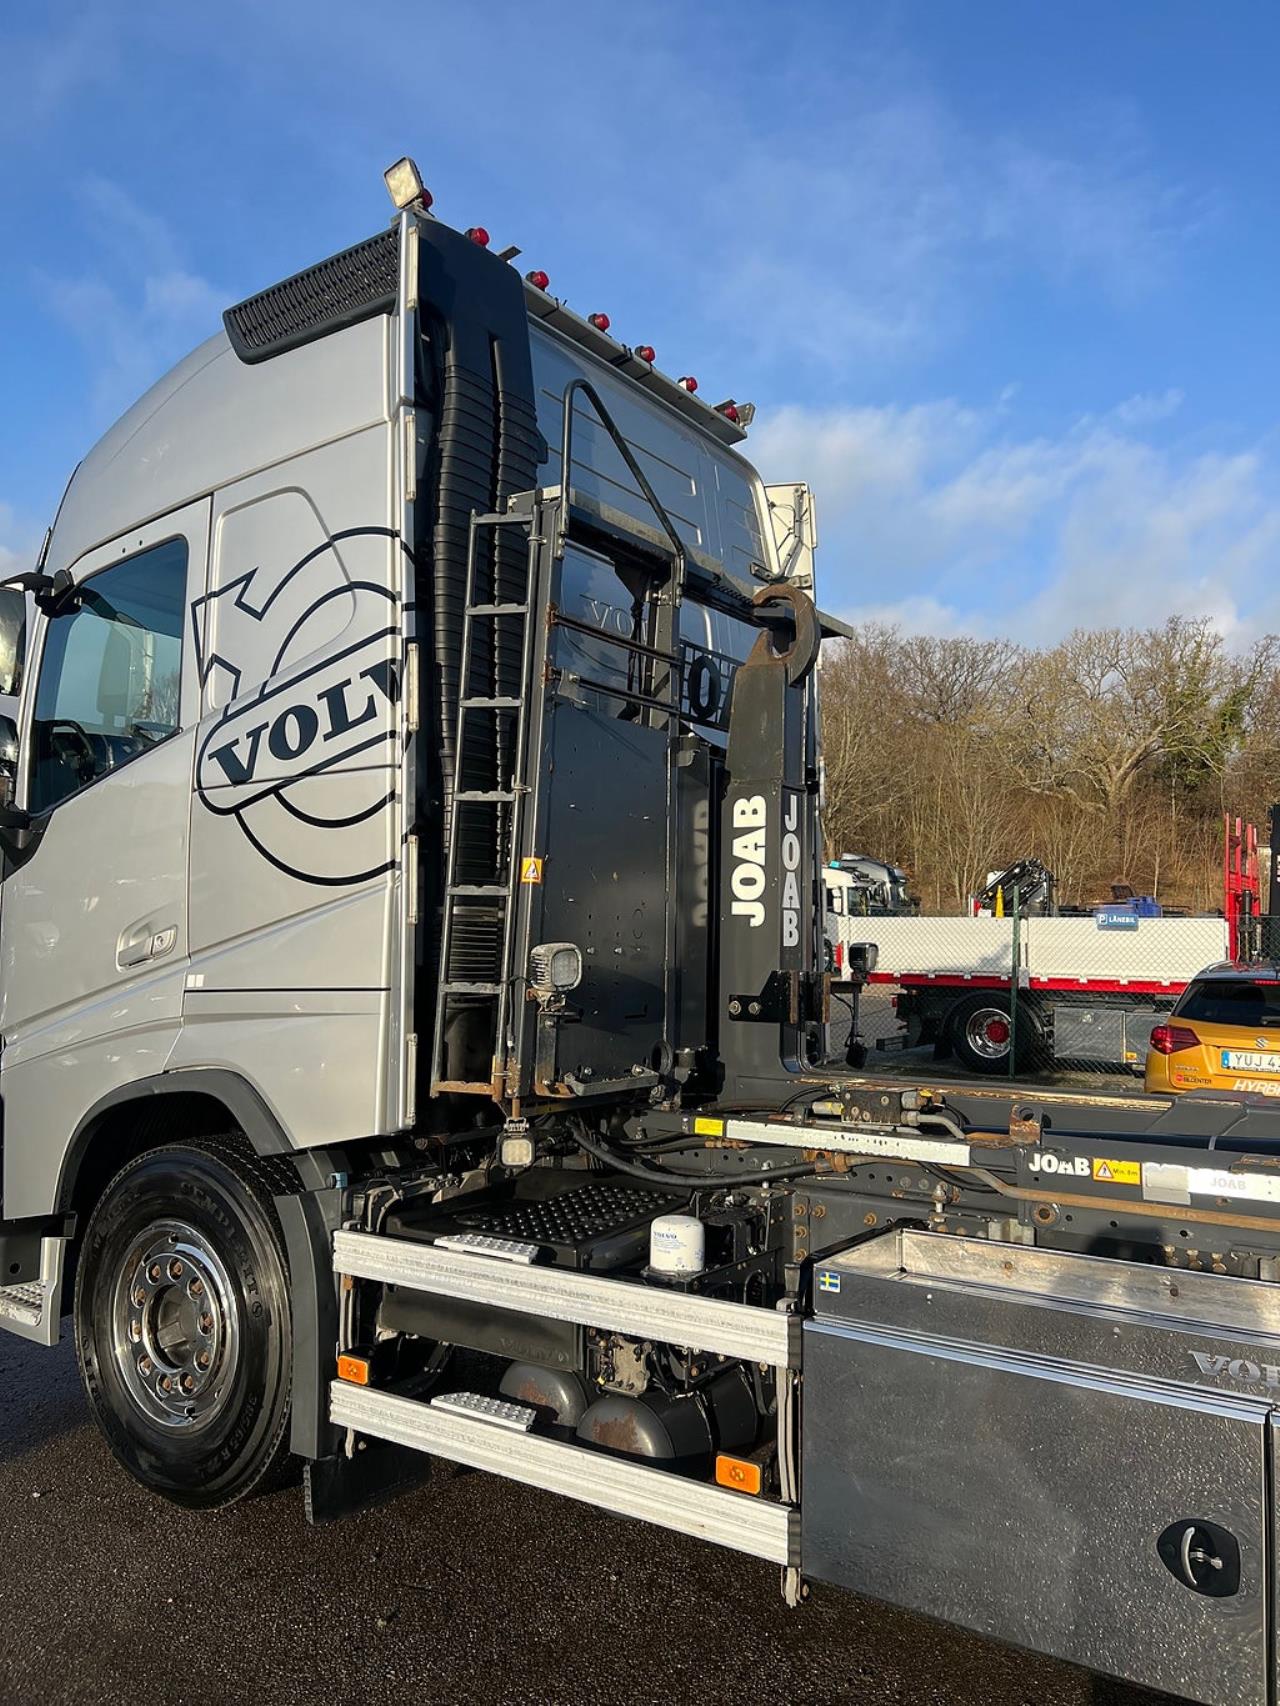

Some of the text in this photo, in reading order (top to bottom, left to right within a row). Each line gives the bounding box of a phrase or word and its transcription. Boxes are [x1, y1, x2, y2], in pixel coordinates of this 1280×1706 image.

[731, 794, 766, 927] JOAB
[782, 794, 800, 947] JOAB
[1235, 1054, 1280, 1067] YUJ 4
[1028, 1153, 1091, 1177] JOAB
[1210, 1177, 1247, 1190] JOAB
